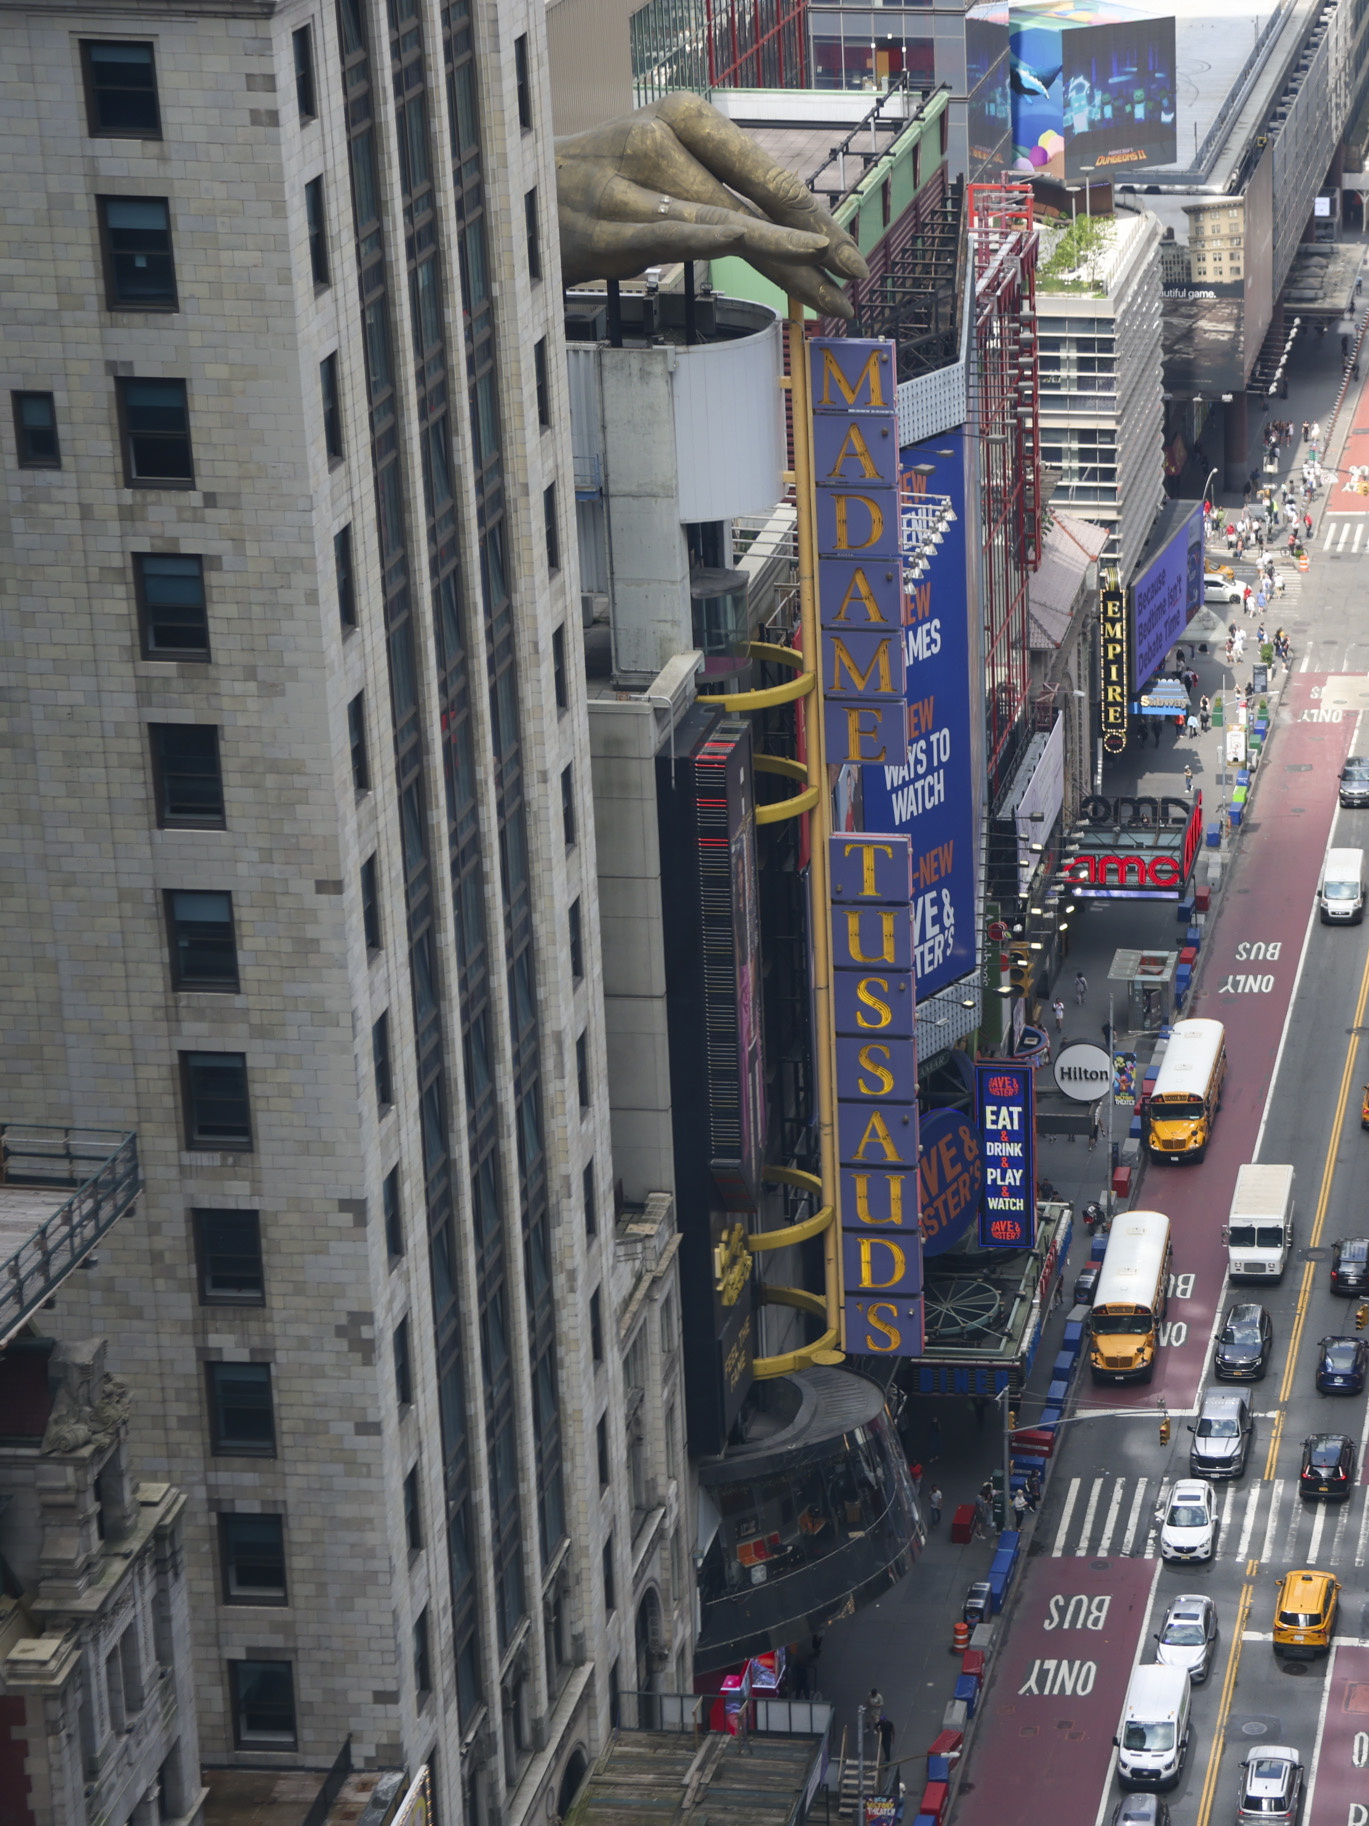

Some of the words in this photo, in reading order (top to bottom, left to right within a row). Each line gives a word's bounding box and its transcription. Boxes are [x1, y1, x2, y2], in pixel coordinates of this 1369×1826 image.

[1095, 152, 1138, 166] DUNGEONS
[1160, 288, 1186, 297] autiful
[1188, 290, 1216, 300] game.
[817, 347, 898, 762] MADAME
[1137, 568, 1166, 616] Because
[1163, 609, 1180, 642] Time
[1104, 600, 1124, 724] EMPIRE
[1140, 695, 1188, 709] Subway
[884, 742, 927, 791] WAYS
[930, 727, 951, 767] TO
[891, 769, 945, 826] WATCH
[1063, 855, 1181, 887] amc
[914, 926, 954, 979] TER'S
[1235, 942, 1282, 960] BUS
[1219, 974, 1275, 993] ONLY
[1060, 1066, 1109, 1081] Hilton
[985, 1105, 1023, 1130] EAT
[958, 1124, 980, 1161] &
[1000, 1131, 1009, 1141] &
[986, 1142, 1023, 1157] DRINK
[1000, 1157, 1009, 1168] &
[987, 1168, 1024, 1186] PLAY
[920, 1158, 982, 1240] STER'S
[1001, 1186, 1010, 1197] &
[988, 1198, 1024, 1211] WATCH
[919, 1367, 1009, 1395] DINER
[1044, 1595, 1111, 1630] BUS
[1018, 1659, 1097, 1695] ONLY
[867, 1807, 895, 1816] THEATER
